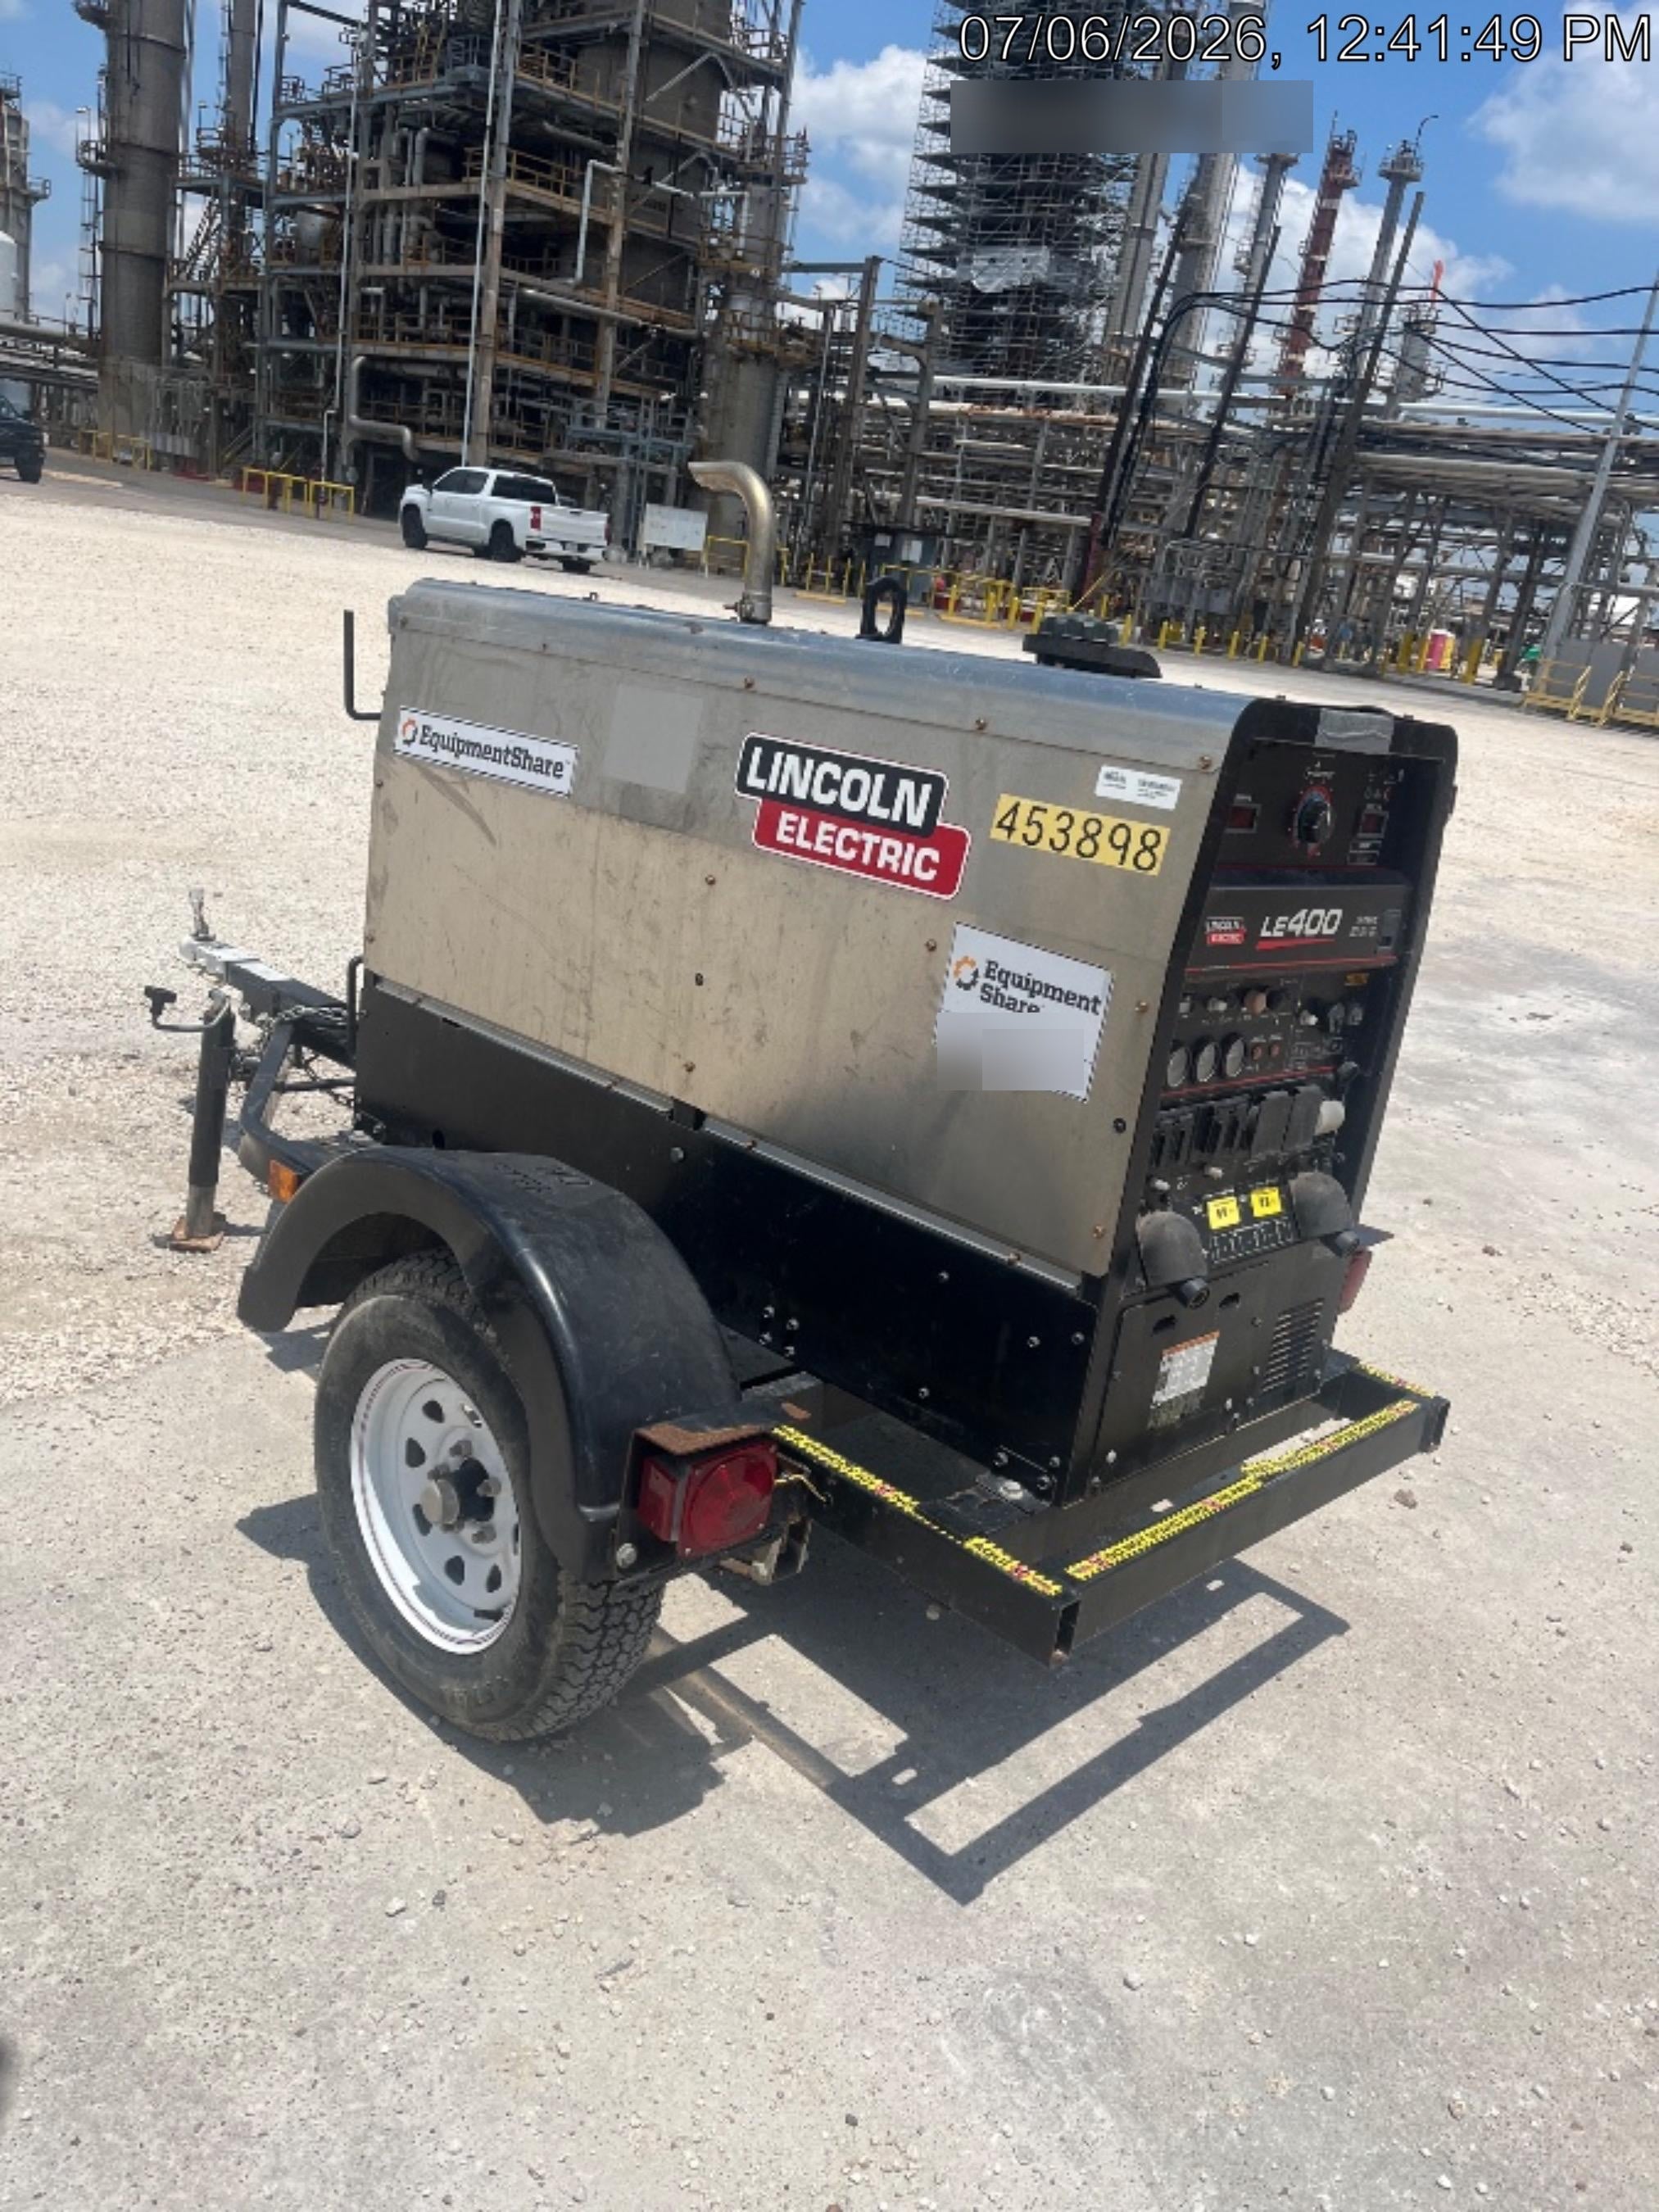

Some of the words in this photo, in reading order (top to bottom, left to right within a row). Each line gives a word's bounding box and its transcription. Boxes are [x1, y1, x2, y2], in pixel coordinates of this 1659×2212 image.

[419, 724, 564, 778] EquipmentShare
[746, 746, 931, 828] LINCOLN
[775, 810, 941, 882] ELECTRIC
[997, 800, 1161, 872] 453898
[1260, 909, 1343, 937] LE400
[984, 959, 1102, 1015] Equipment
